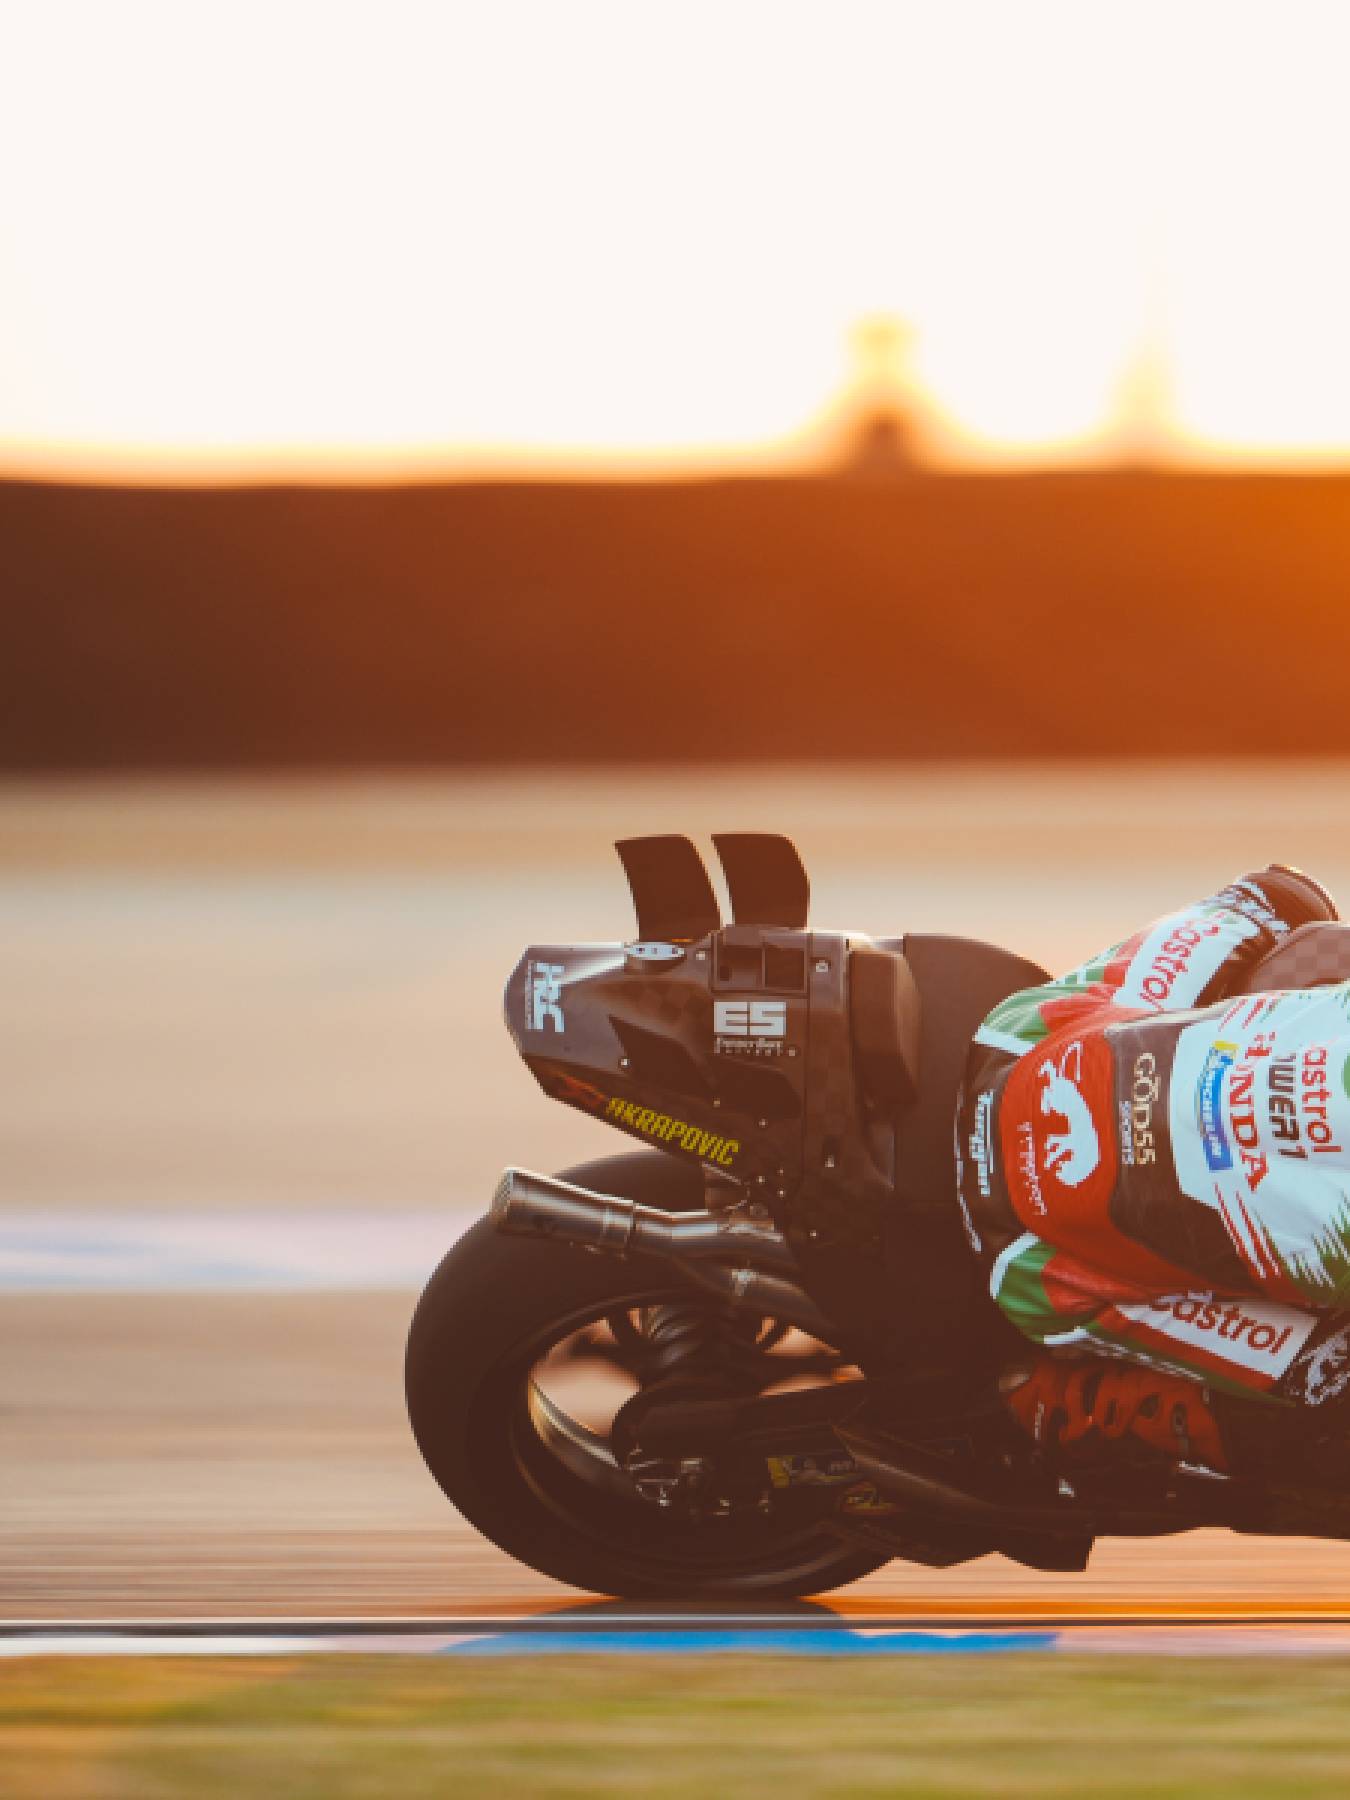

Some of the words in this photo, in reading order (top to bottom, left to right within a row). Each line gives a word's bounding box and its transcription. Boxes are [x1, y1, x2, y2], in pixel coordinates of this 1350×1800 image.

[1229, 1031, 1276, 1192] HNDA
[1269, 1053, 1308, 1159] WER1
[1302, 1045, 1343, 1153] astrol
